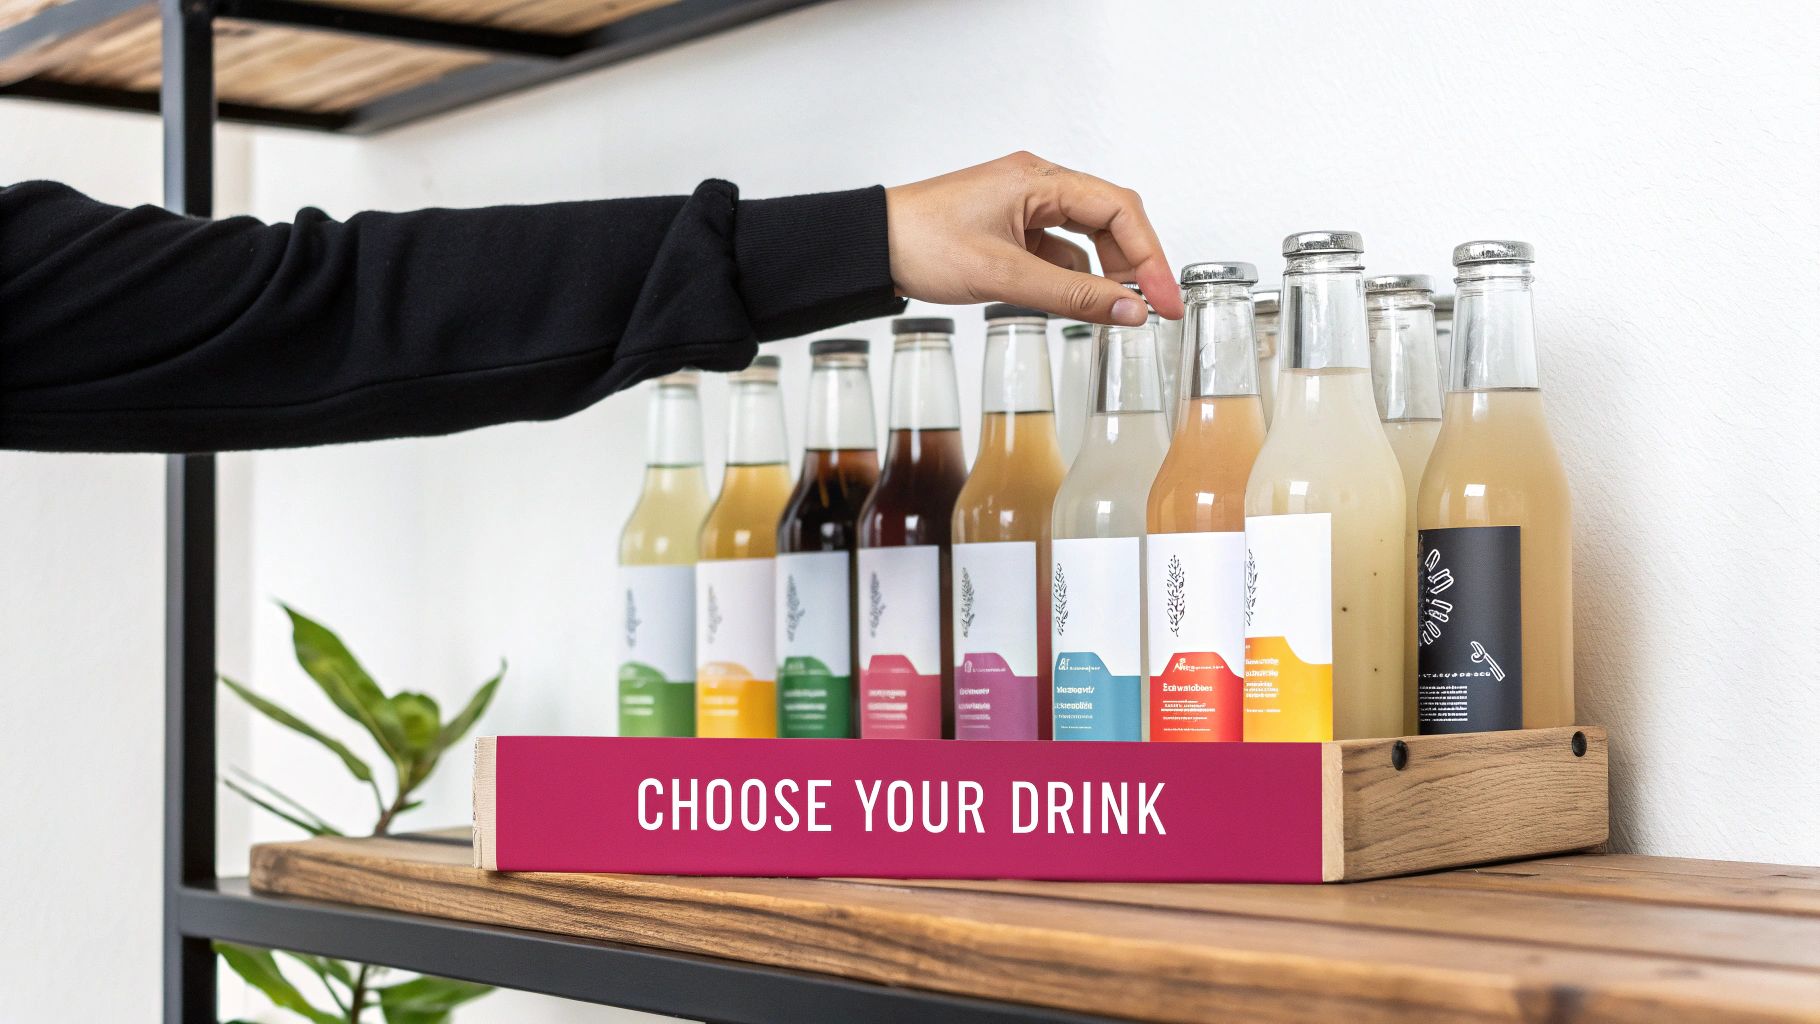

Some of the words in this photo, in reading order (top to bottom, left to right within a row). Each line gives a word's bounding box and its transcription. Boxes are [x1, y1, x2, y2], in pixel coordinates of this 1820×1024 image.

[637, 777, 832, 832] CHOOSE
[854, 779, 986, 834] YOUR
[1012, 780, 1167, 835] DRINK
